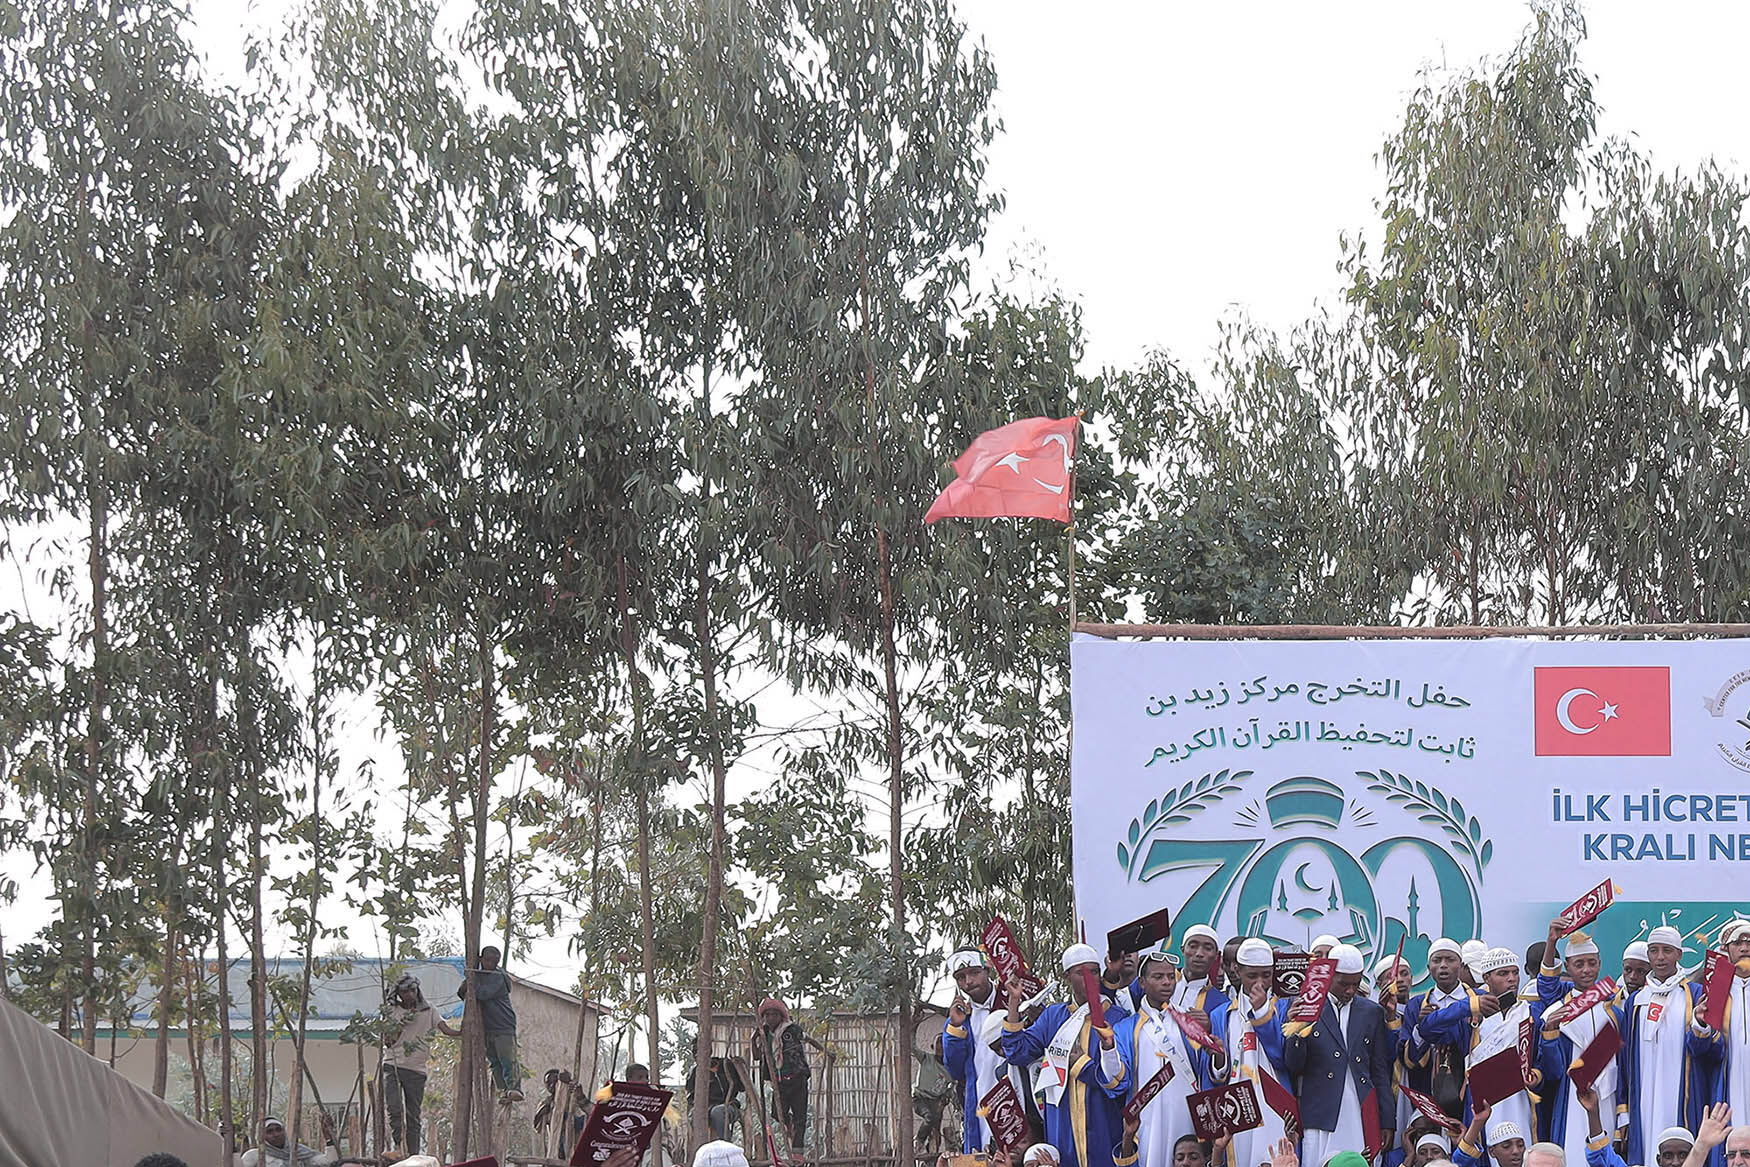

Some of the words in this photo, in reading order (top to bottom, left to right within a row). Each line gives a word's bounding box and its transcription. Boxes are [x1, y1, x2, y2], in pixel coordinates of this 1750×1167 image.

[1145, 691, 1178, 717] بن
[1184, 680, 1232, 710] زيد
[1237, 676, 1300, 705] مركز
[1306, 677, 1401, 705] التخرج
[1406, 683, 1472, 708] حفل
[1144, 725, 1226, 768] الكريم
[1231, 717, 1310, 750] القرآن
[1315, 720, 1413, 751] لتحفيظ
[1417, 733, 1476, 764] ثابت
[1553, 788, 1610, 822] İLK
[1584, 832, 1697, 862] KRALI
